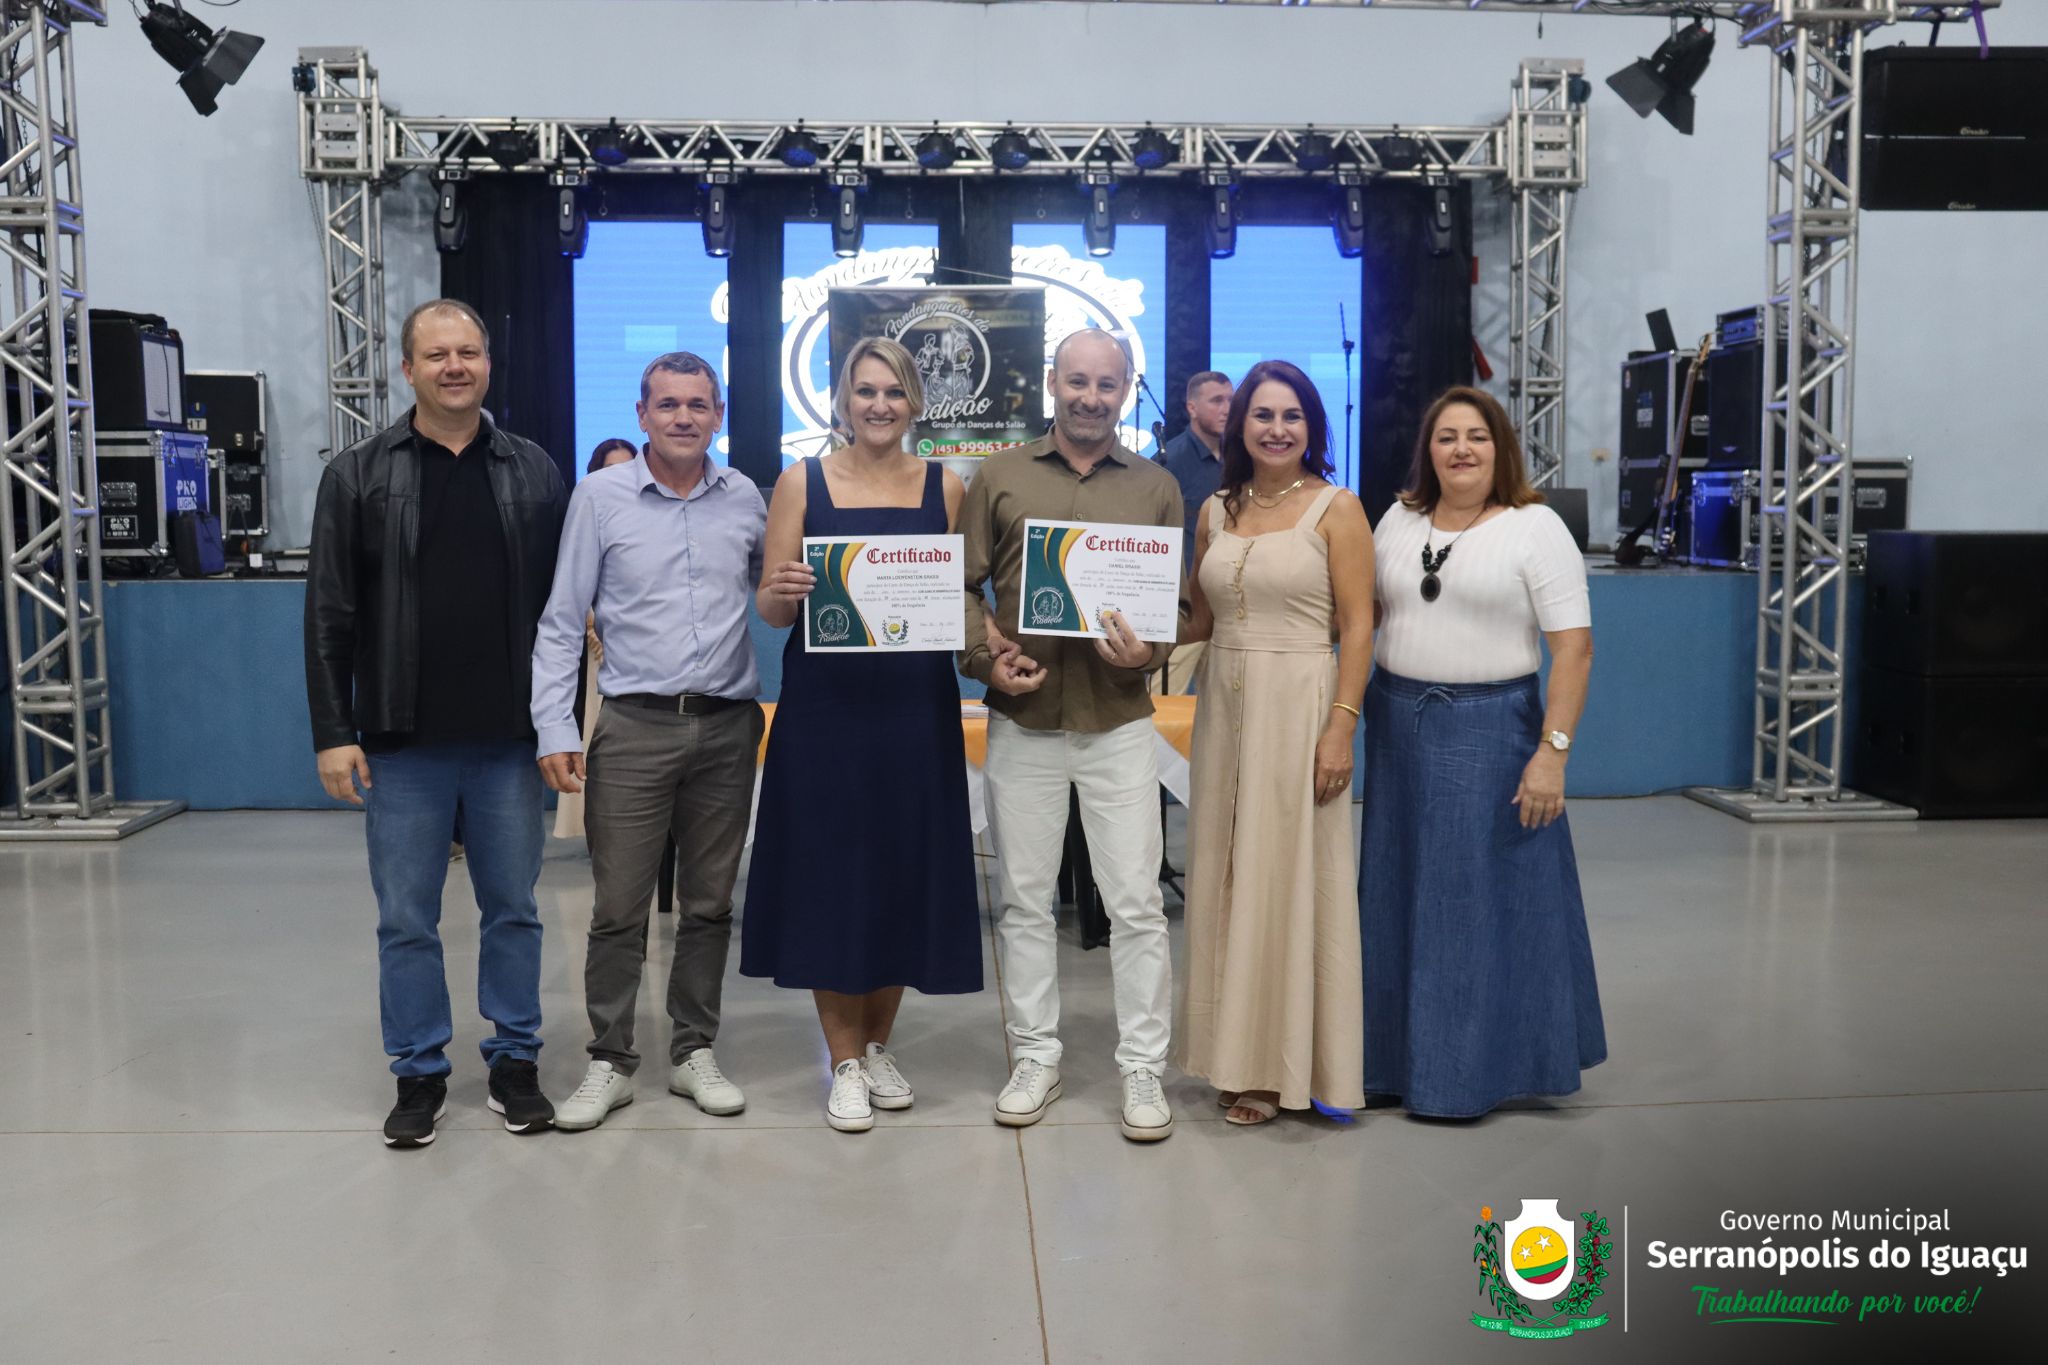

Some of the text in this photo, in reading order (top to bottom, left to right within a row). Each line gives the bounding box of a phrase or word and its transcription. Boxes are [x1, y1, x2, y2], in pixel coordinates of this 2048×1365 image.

[885, 301, 974, 336] Fandangueiros
[917, 394, 993, 422] dição
[931, 421, 954, 430] Grupo
[967, 421, 993, 430] Danças
[995, 420, 1004, 428] de
[1005, 420, 1026, 428] Salão
[936, 441, 1025, 454] (45) 99963-6
[1085, 534, 1169, 554] Certificado
[866, 548, 952, 564] Certificado
